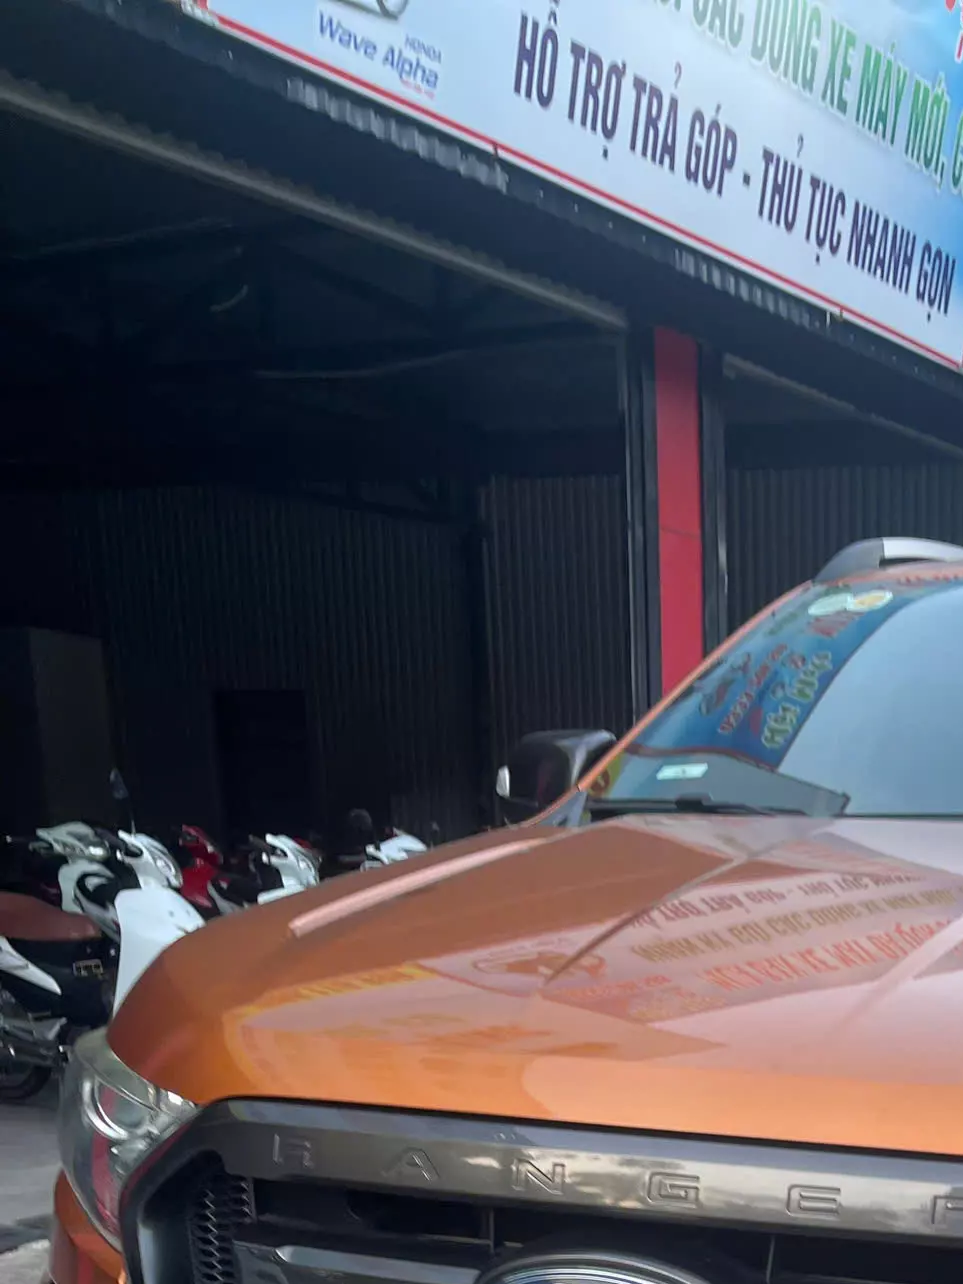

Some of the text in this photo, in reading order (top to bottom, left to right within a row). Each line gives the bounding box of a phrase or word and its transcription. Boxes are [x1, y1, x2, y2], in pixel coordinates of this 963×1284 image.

[318, 10, 378, 61] Wave
[382, 44, 439, 89] Alpha
[821, 16, 857, 116] XE
[855, 41, 908, 147] MÁY
[567, 38, 626, 160] TRỢ
[629, 61, 682, 174] TRẢ
[685, 103, 738, 198] GÓP
[758, 134, 804, 235] THỦ
[805, 173, 846, 265] TỤC
[846, 200, 917, 295] NHANH
[916, 240, 956, 322] GỌN
